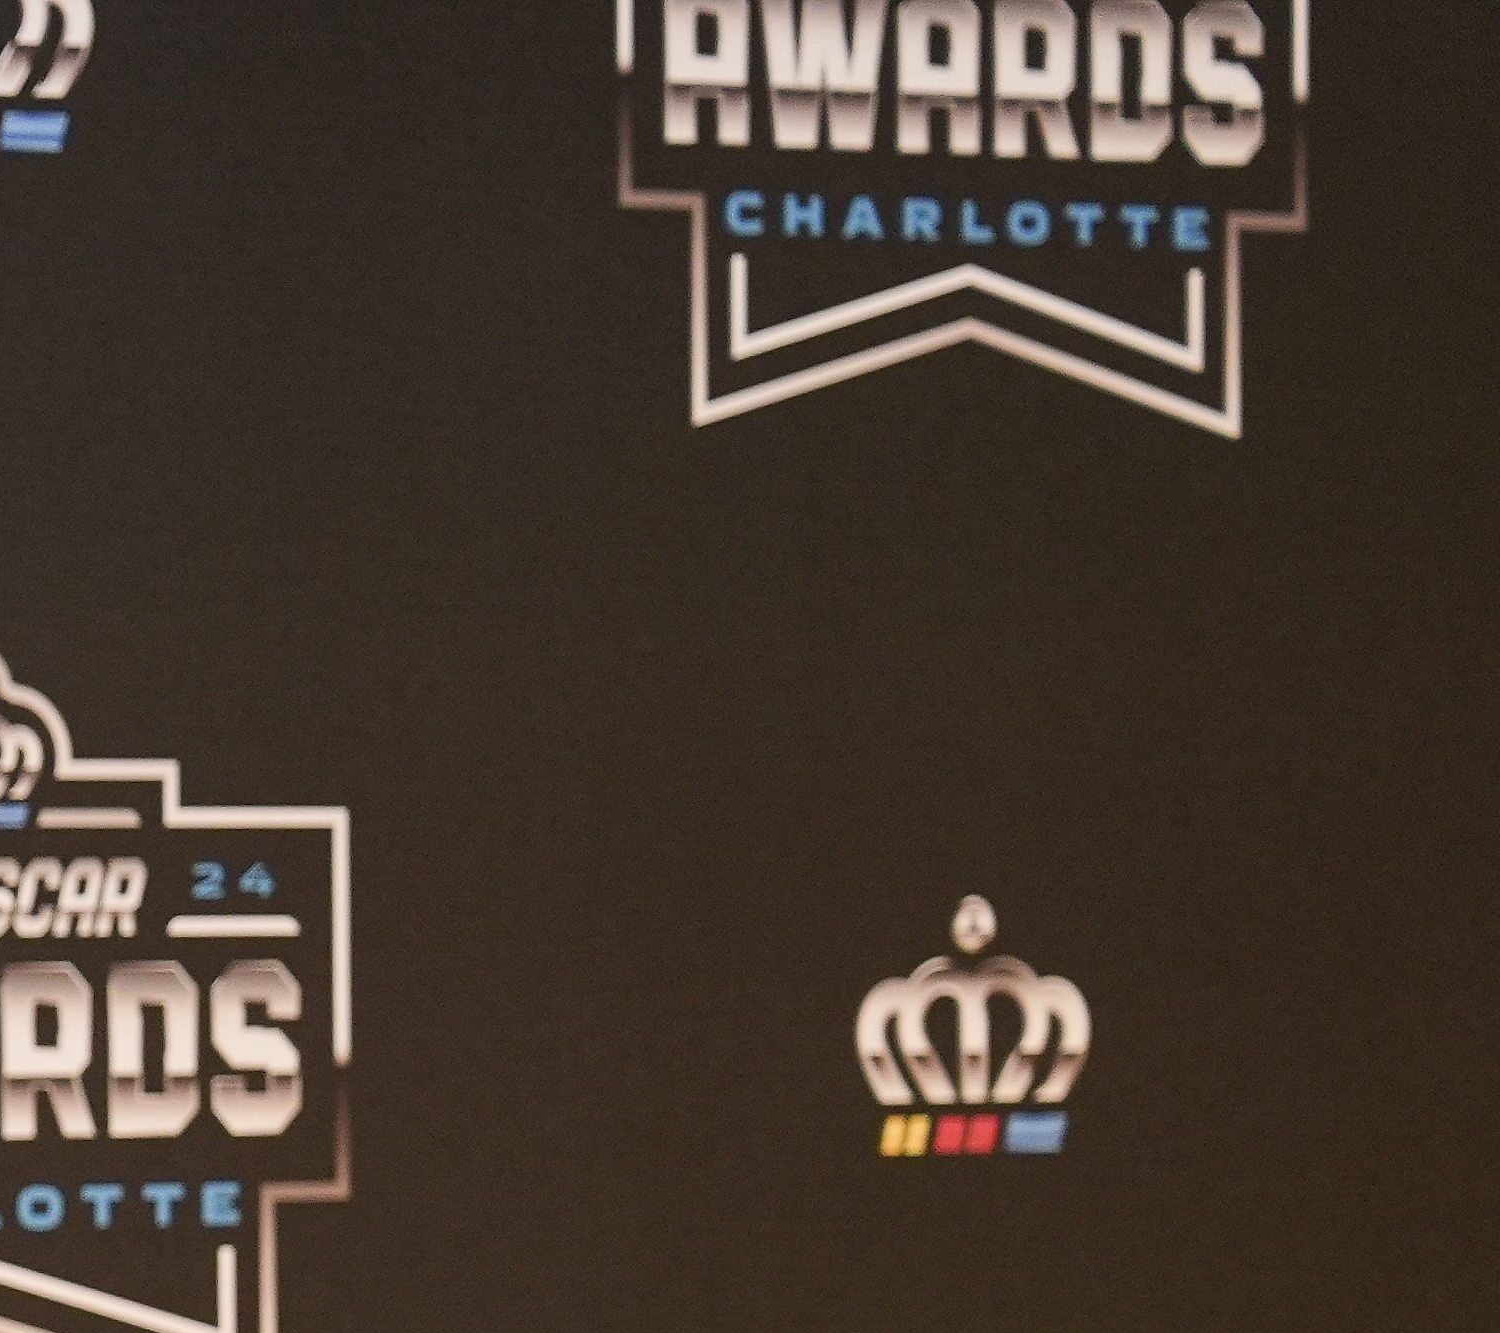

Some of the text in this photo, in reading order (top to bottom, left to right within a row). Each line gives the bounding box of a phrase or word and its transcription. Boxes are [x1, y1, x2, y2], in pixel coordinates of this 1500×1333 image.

[664, 0, 1263, 165] AWARDS
[723, 188, 1209, 251] CHARLOTTE
[195, 860, 276, 900] 24
